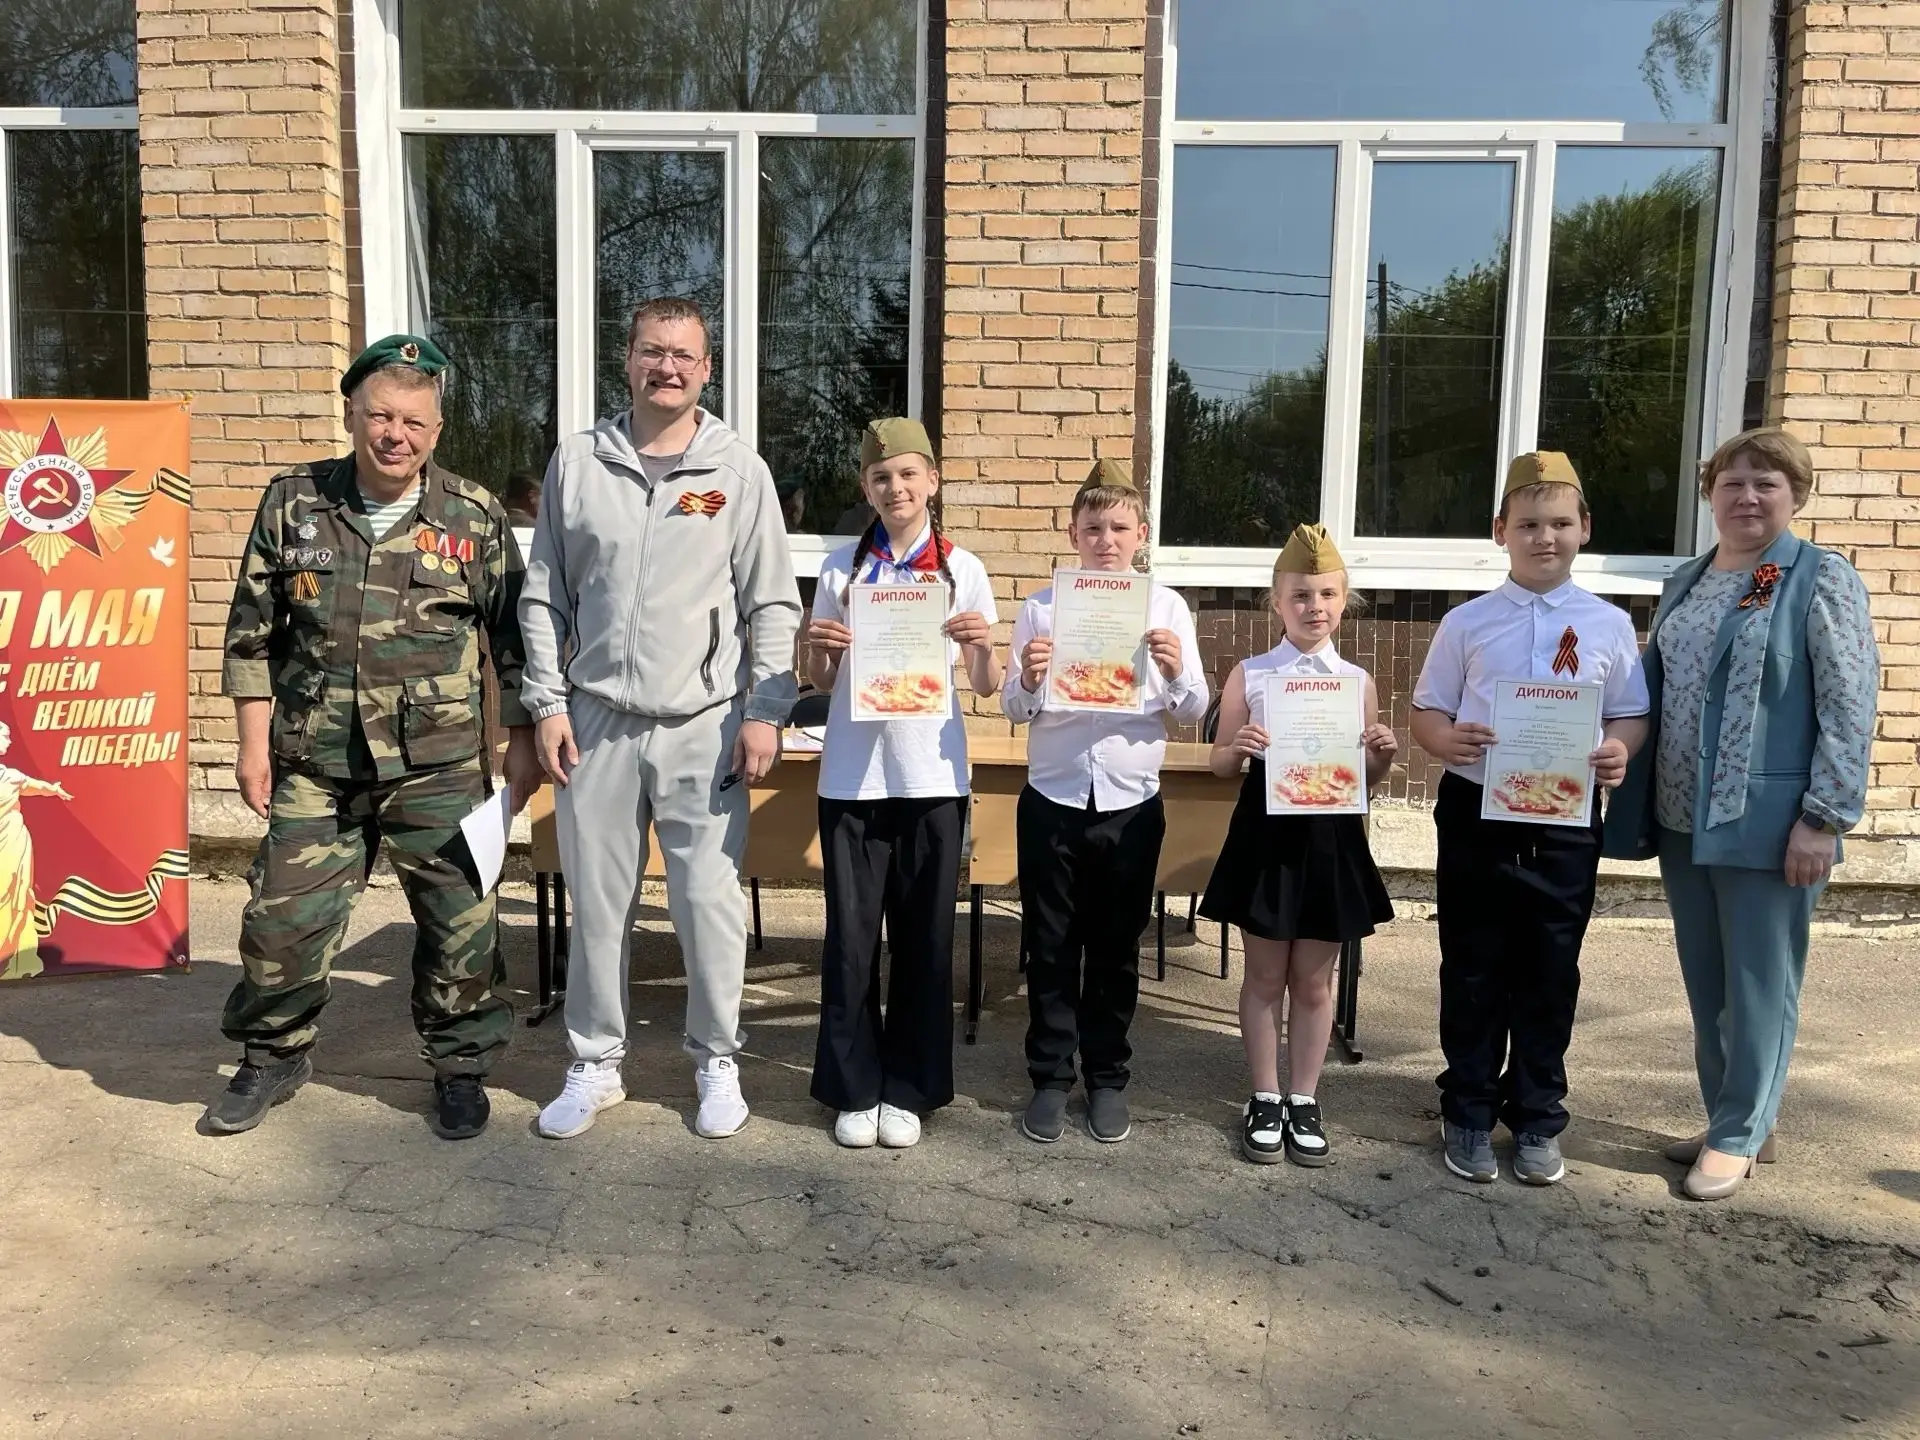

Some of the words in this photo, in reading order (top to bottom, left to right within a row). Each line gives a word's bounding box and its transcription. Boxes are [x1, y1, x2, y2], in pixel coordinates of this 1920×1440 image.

[8, 458, 85, 525] ОТЕЧЕСТВЕННАЯ
[871, 591, 927, 604] ДИПЛОМ
[1074, 578, 1131, 591] ДИПЛОМ
[29, 587, 165, 649] МАЯ
[17, 656, 101, 698] ДНЁМ
[1285, 681, 1341, 693] ДИПЛОМ
[1515, 687, 1578, 700] ДИПЛОМ
[31, 691, 156, 731] ВЕЛИКОЙ
[60, 731, 181, 769] ПОБЕДЫ!
